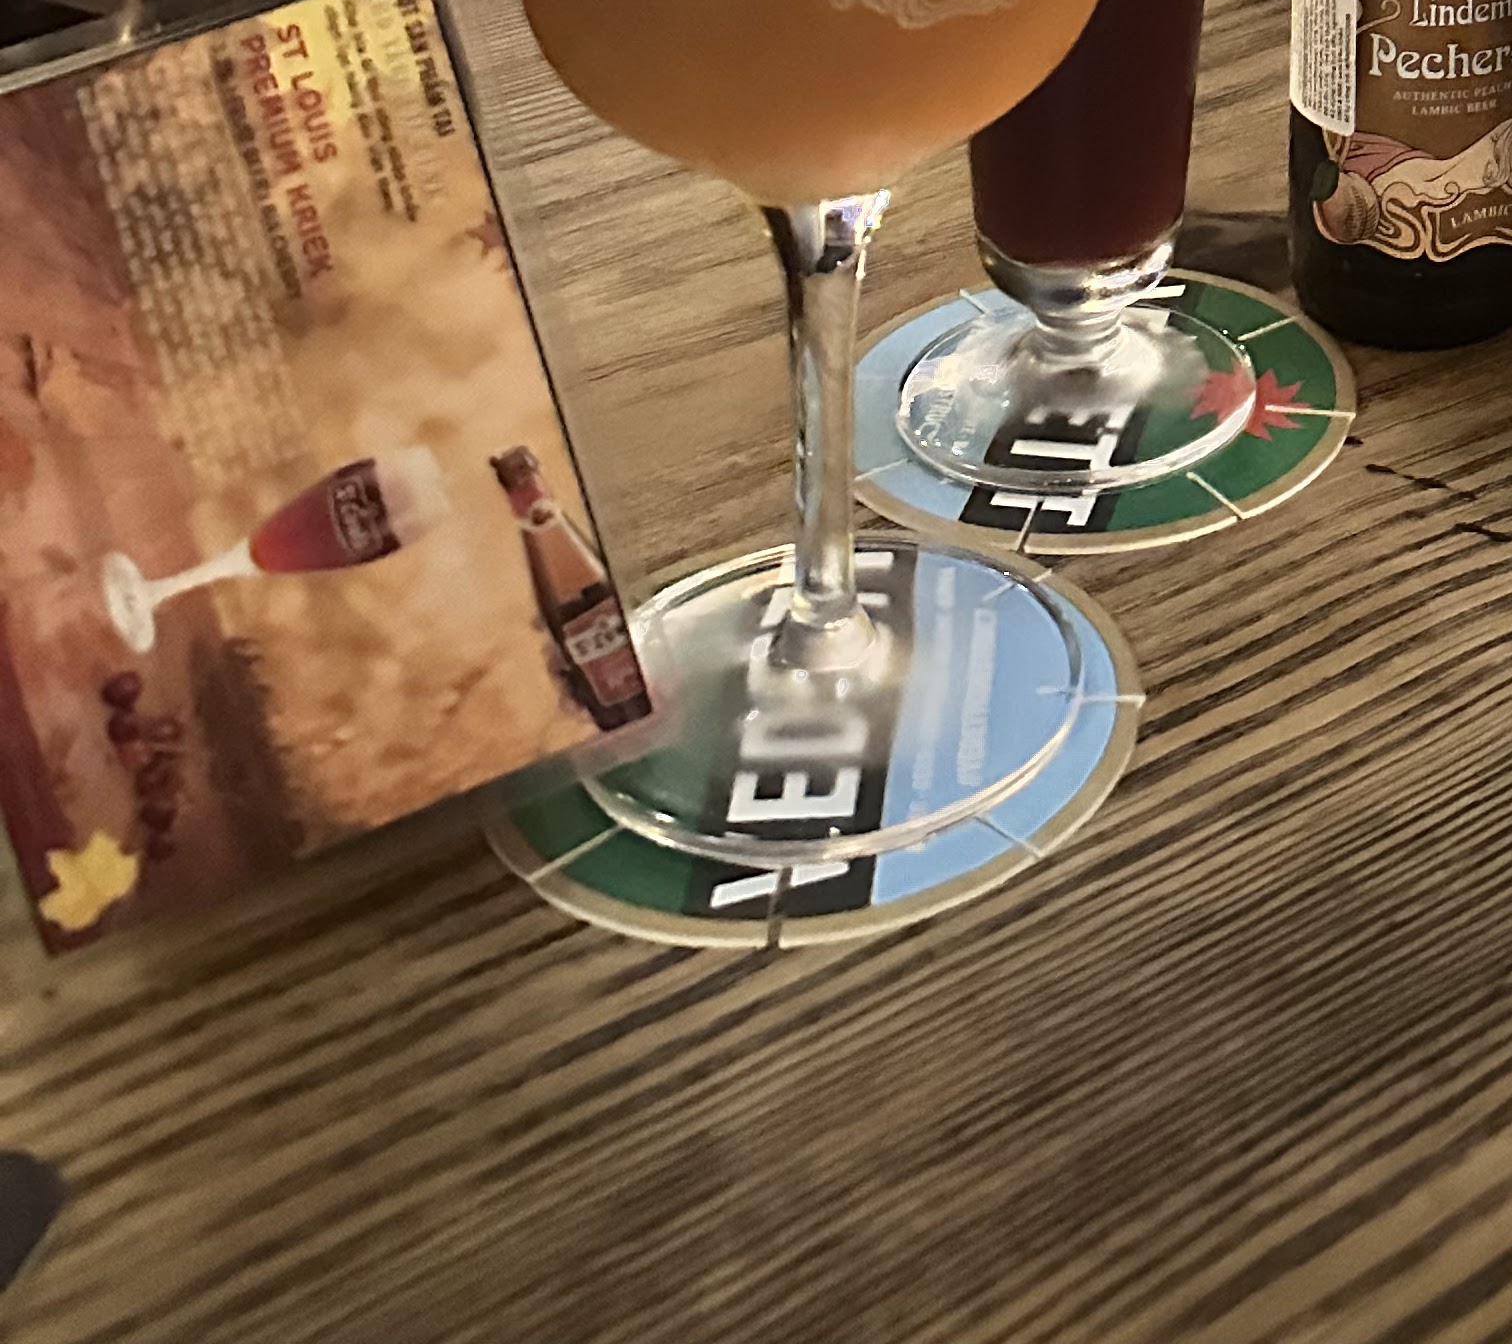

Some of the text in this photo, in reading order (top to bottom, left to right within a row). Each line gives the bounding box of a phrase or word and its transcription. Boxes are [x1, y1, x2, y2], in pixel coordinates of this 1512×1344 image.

[240, 32, 305, 178] PREMIUM
[285, 182, 334, 280] KRIEK
[276, 22, 339, 165] ST LOUIS
[1392, 87, 1470, 102] AUTHENTIC
